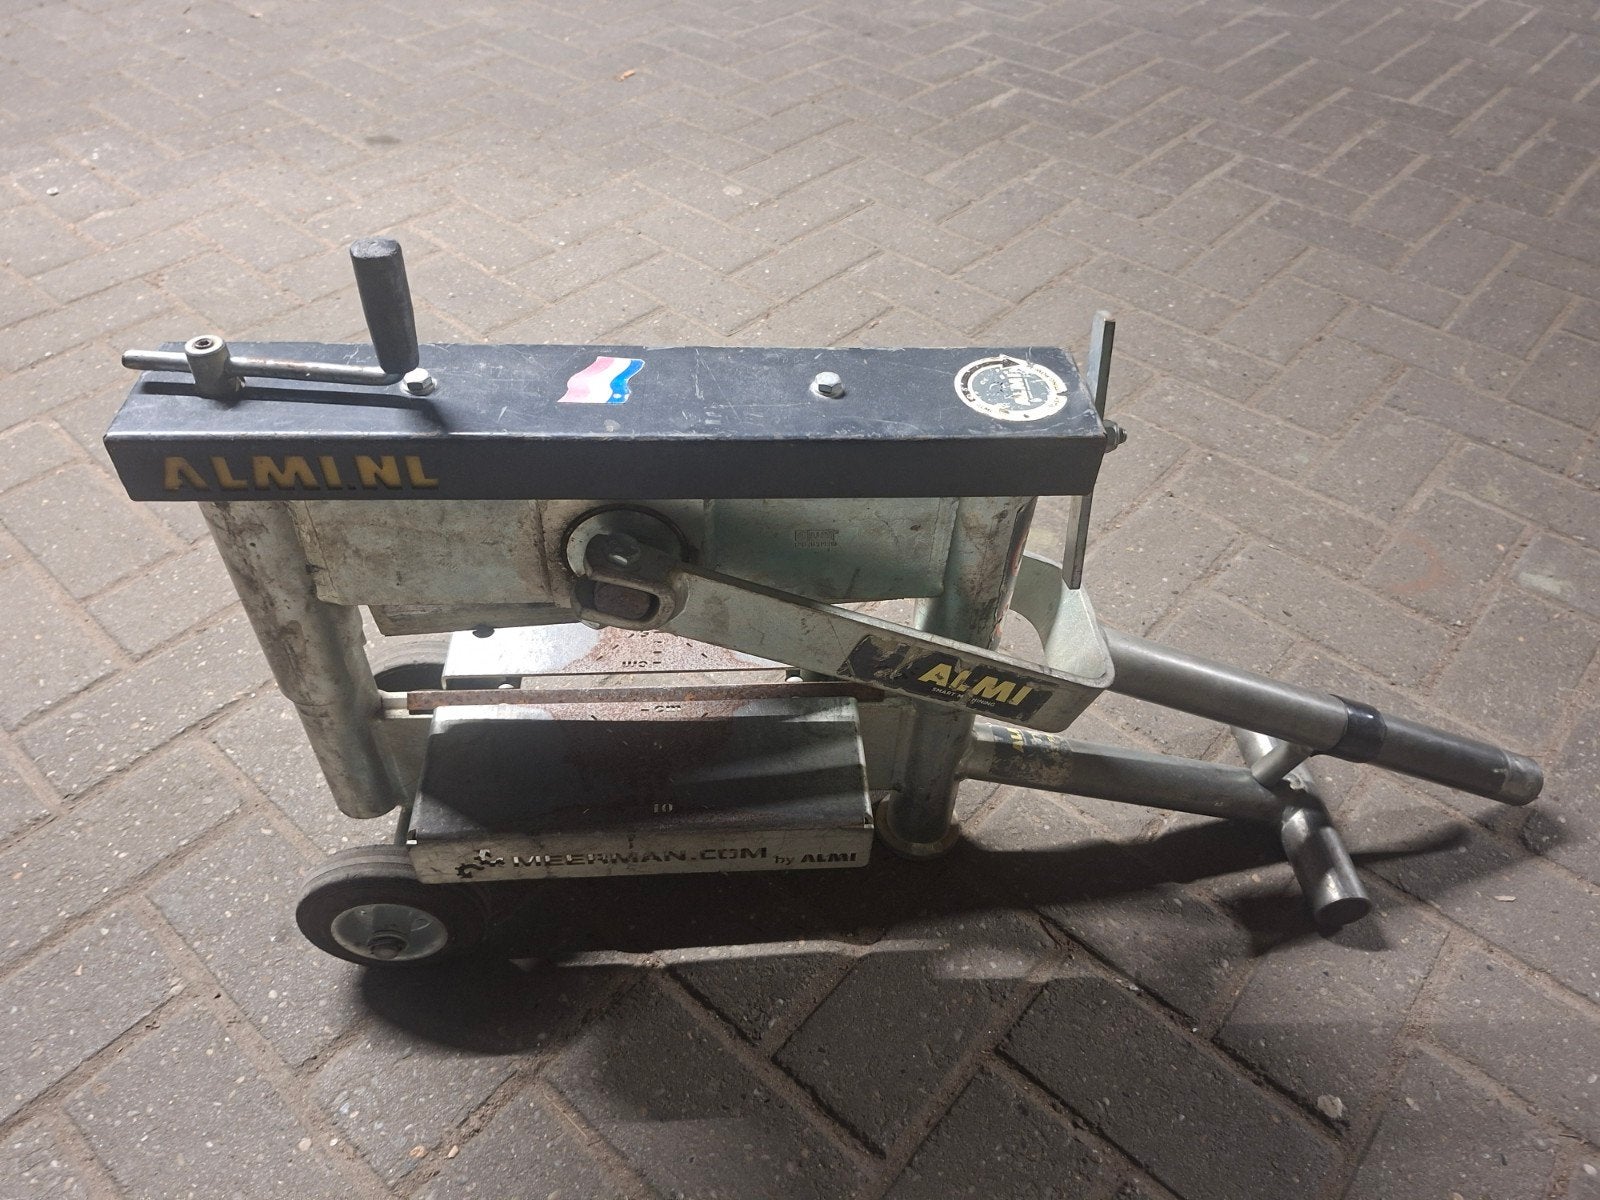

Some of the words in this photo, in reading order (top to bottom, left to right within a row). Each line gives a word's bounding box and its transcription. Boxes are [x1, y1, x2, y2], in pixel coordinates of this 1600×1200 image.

[164, 455, 440, 490] ALMI.NL
[918, 663, 1033, 706] ALMI
[931, 687, 956, 697] SMART
[513, 847, 768, 867] MEERMAN.COM
[774, 854, 795, 866] by
[800, 853, 857, 863] ALMI
